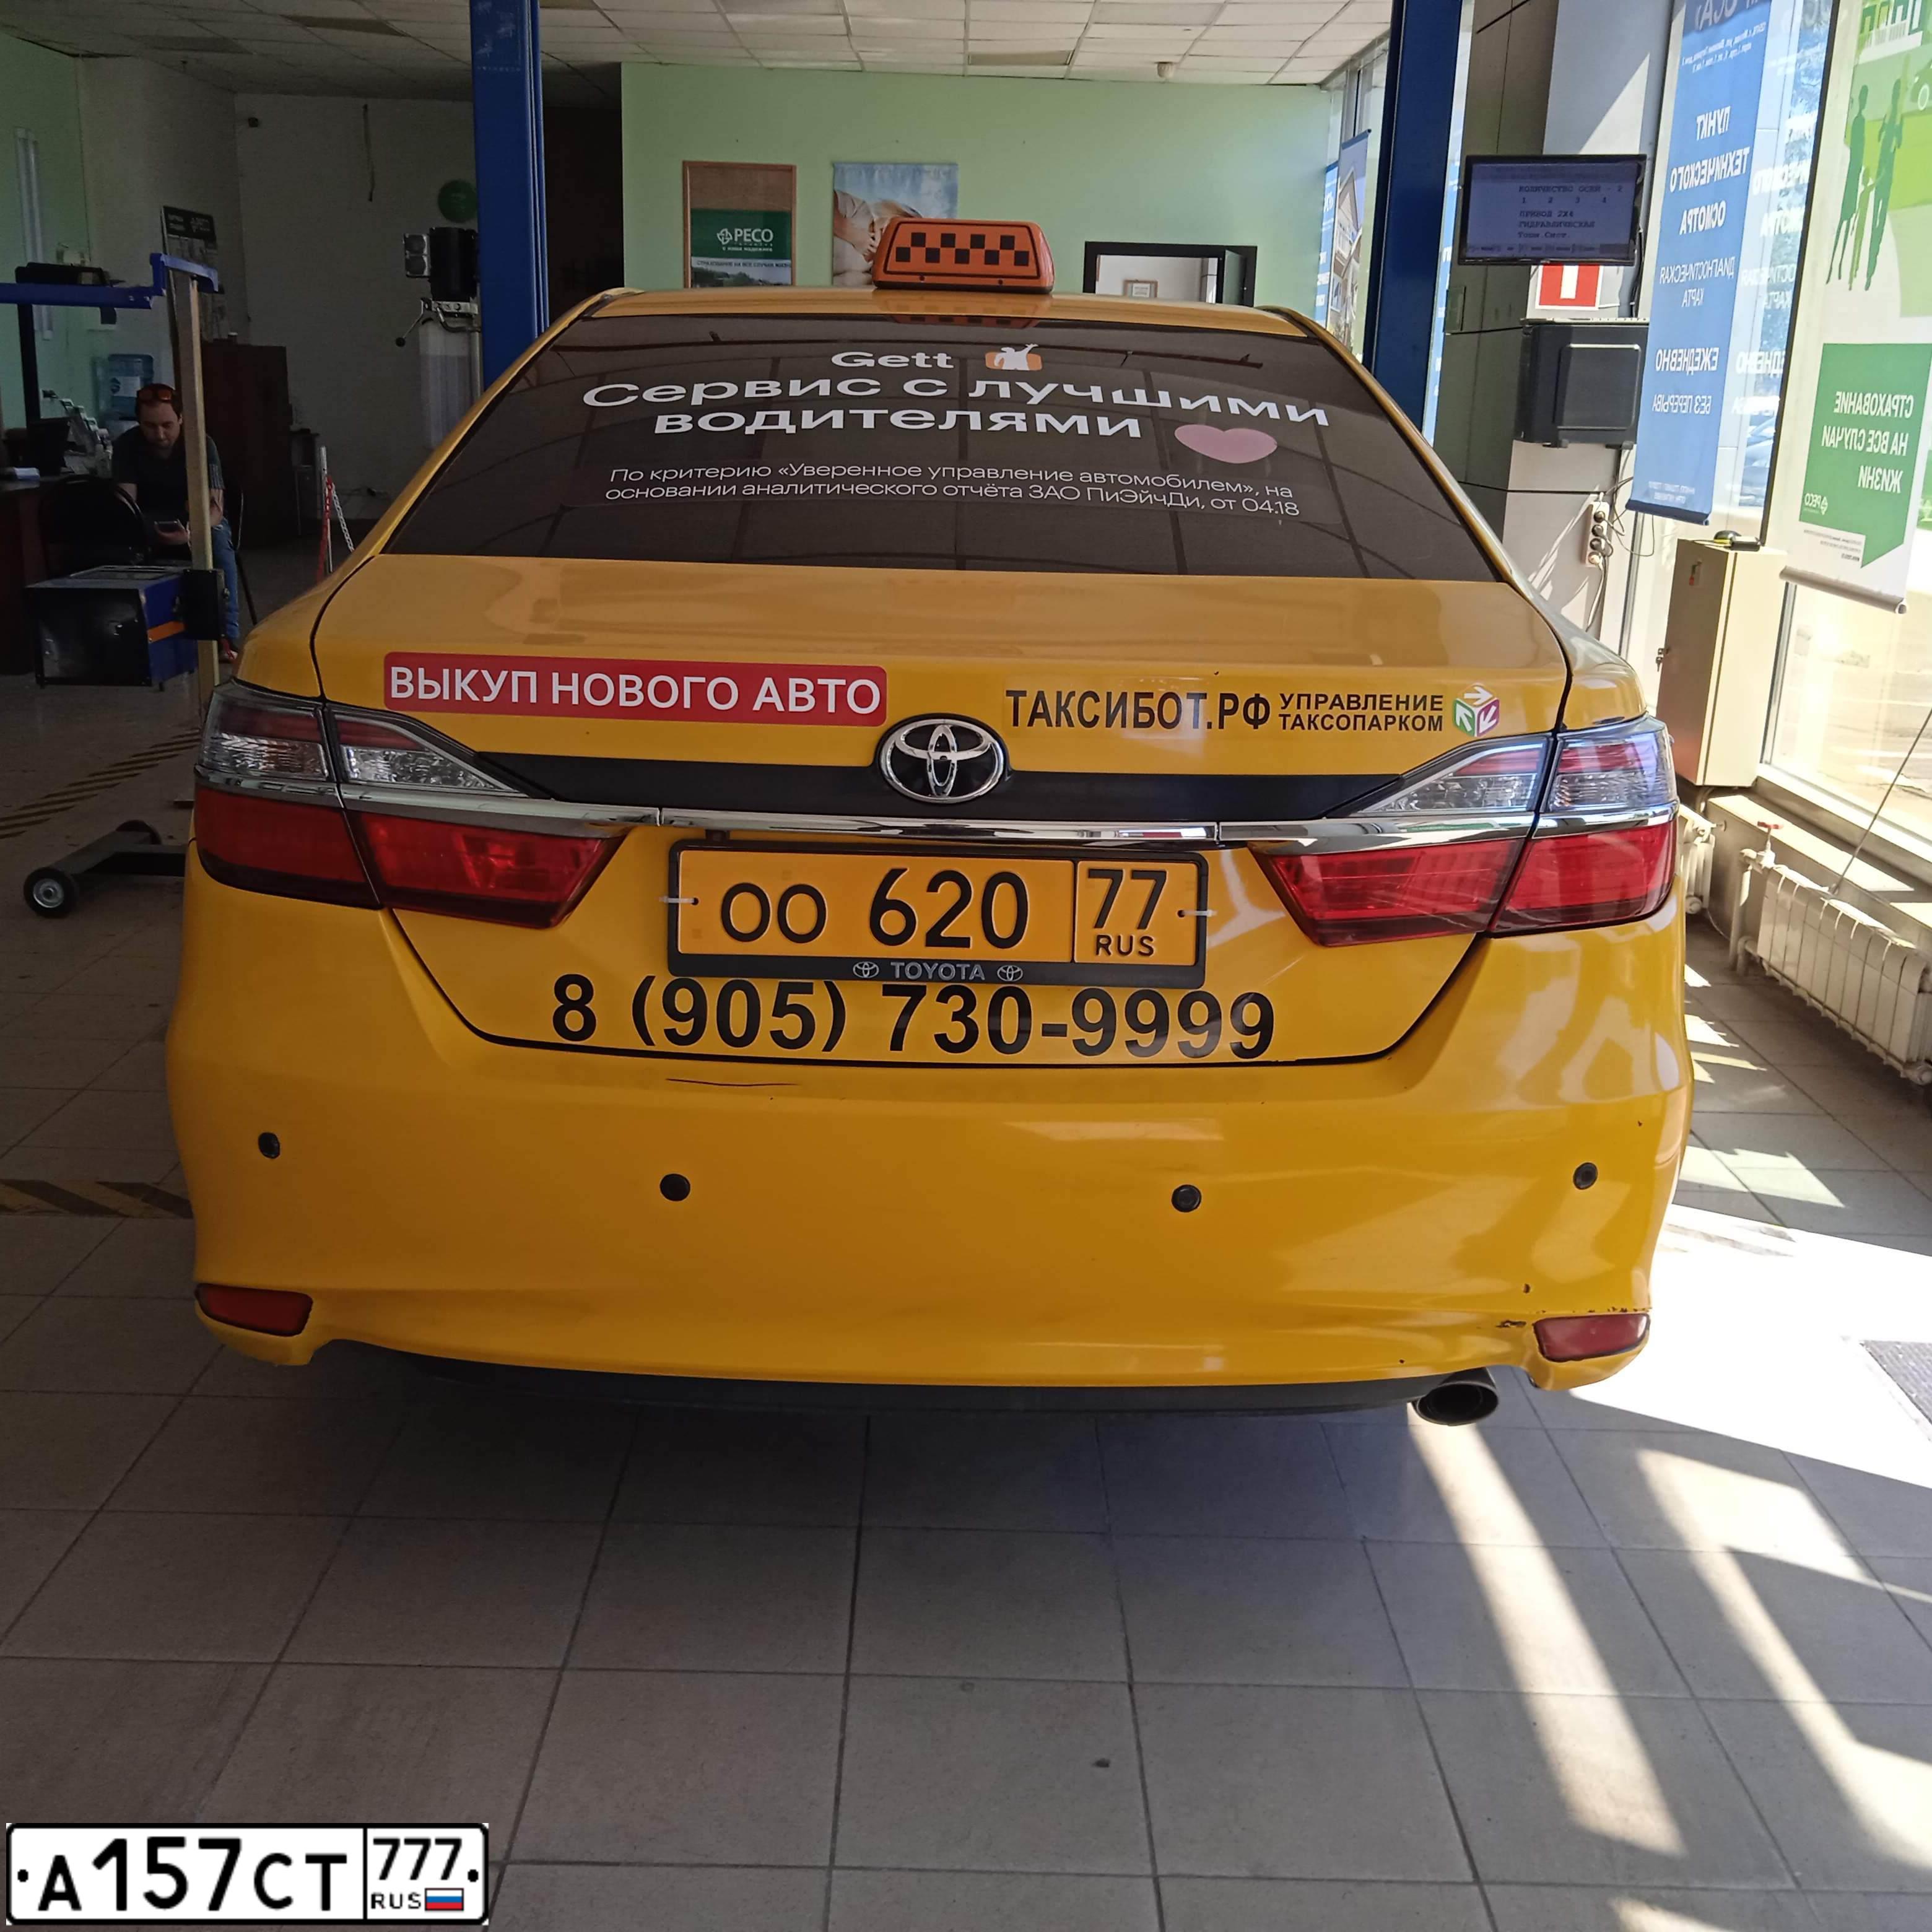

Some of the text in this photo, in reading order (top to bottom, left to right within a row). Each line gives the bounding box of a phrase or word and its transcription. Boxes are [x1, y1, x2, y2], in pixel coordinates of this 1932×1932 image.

[734, 228, 773, 242] РЕСО
[831, 352, 954, 369] Gett
[583, 378, 1329, 426] Сервис с лучшими
[655, 409, 1141, 438] водителями
[610, 463, 1293, 498] По критерию «Уверенное управление автомобилем», на
[606, 482, 1300, 516] основании аналитического отчёта ЗАО ПиЭйчДи, от 04.18
[390, 666, 882, 715] ВЫКУП НОВОГО АВТО
[1279, 693, 1443, 711] УПРАВЛЕНИЕ
[1006, 690, 1271, 730] ТАКСИБОТ.РФ
[1279, 713, 1443, 732] ТАКСОПАРКОМ
[869, 868, 1028, 949] 620
[1087, 868, 1168, 931] 77
[1095, 934, 1154, 958] RUS
[890, 961, 985, 981] TOYOTA
[552, 974, 1276, 1060] 8 (905) 730-9999
